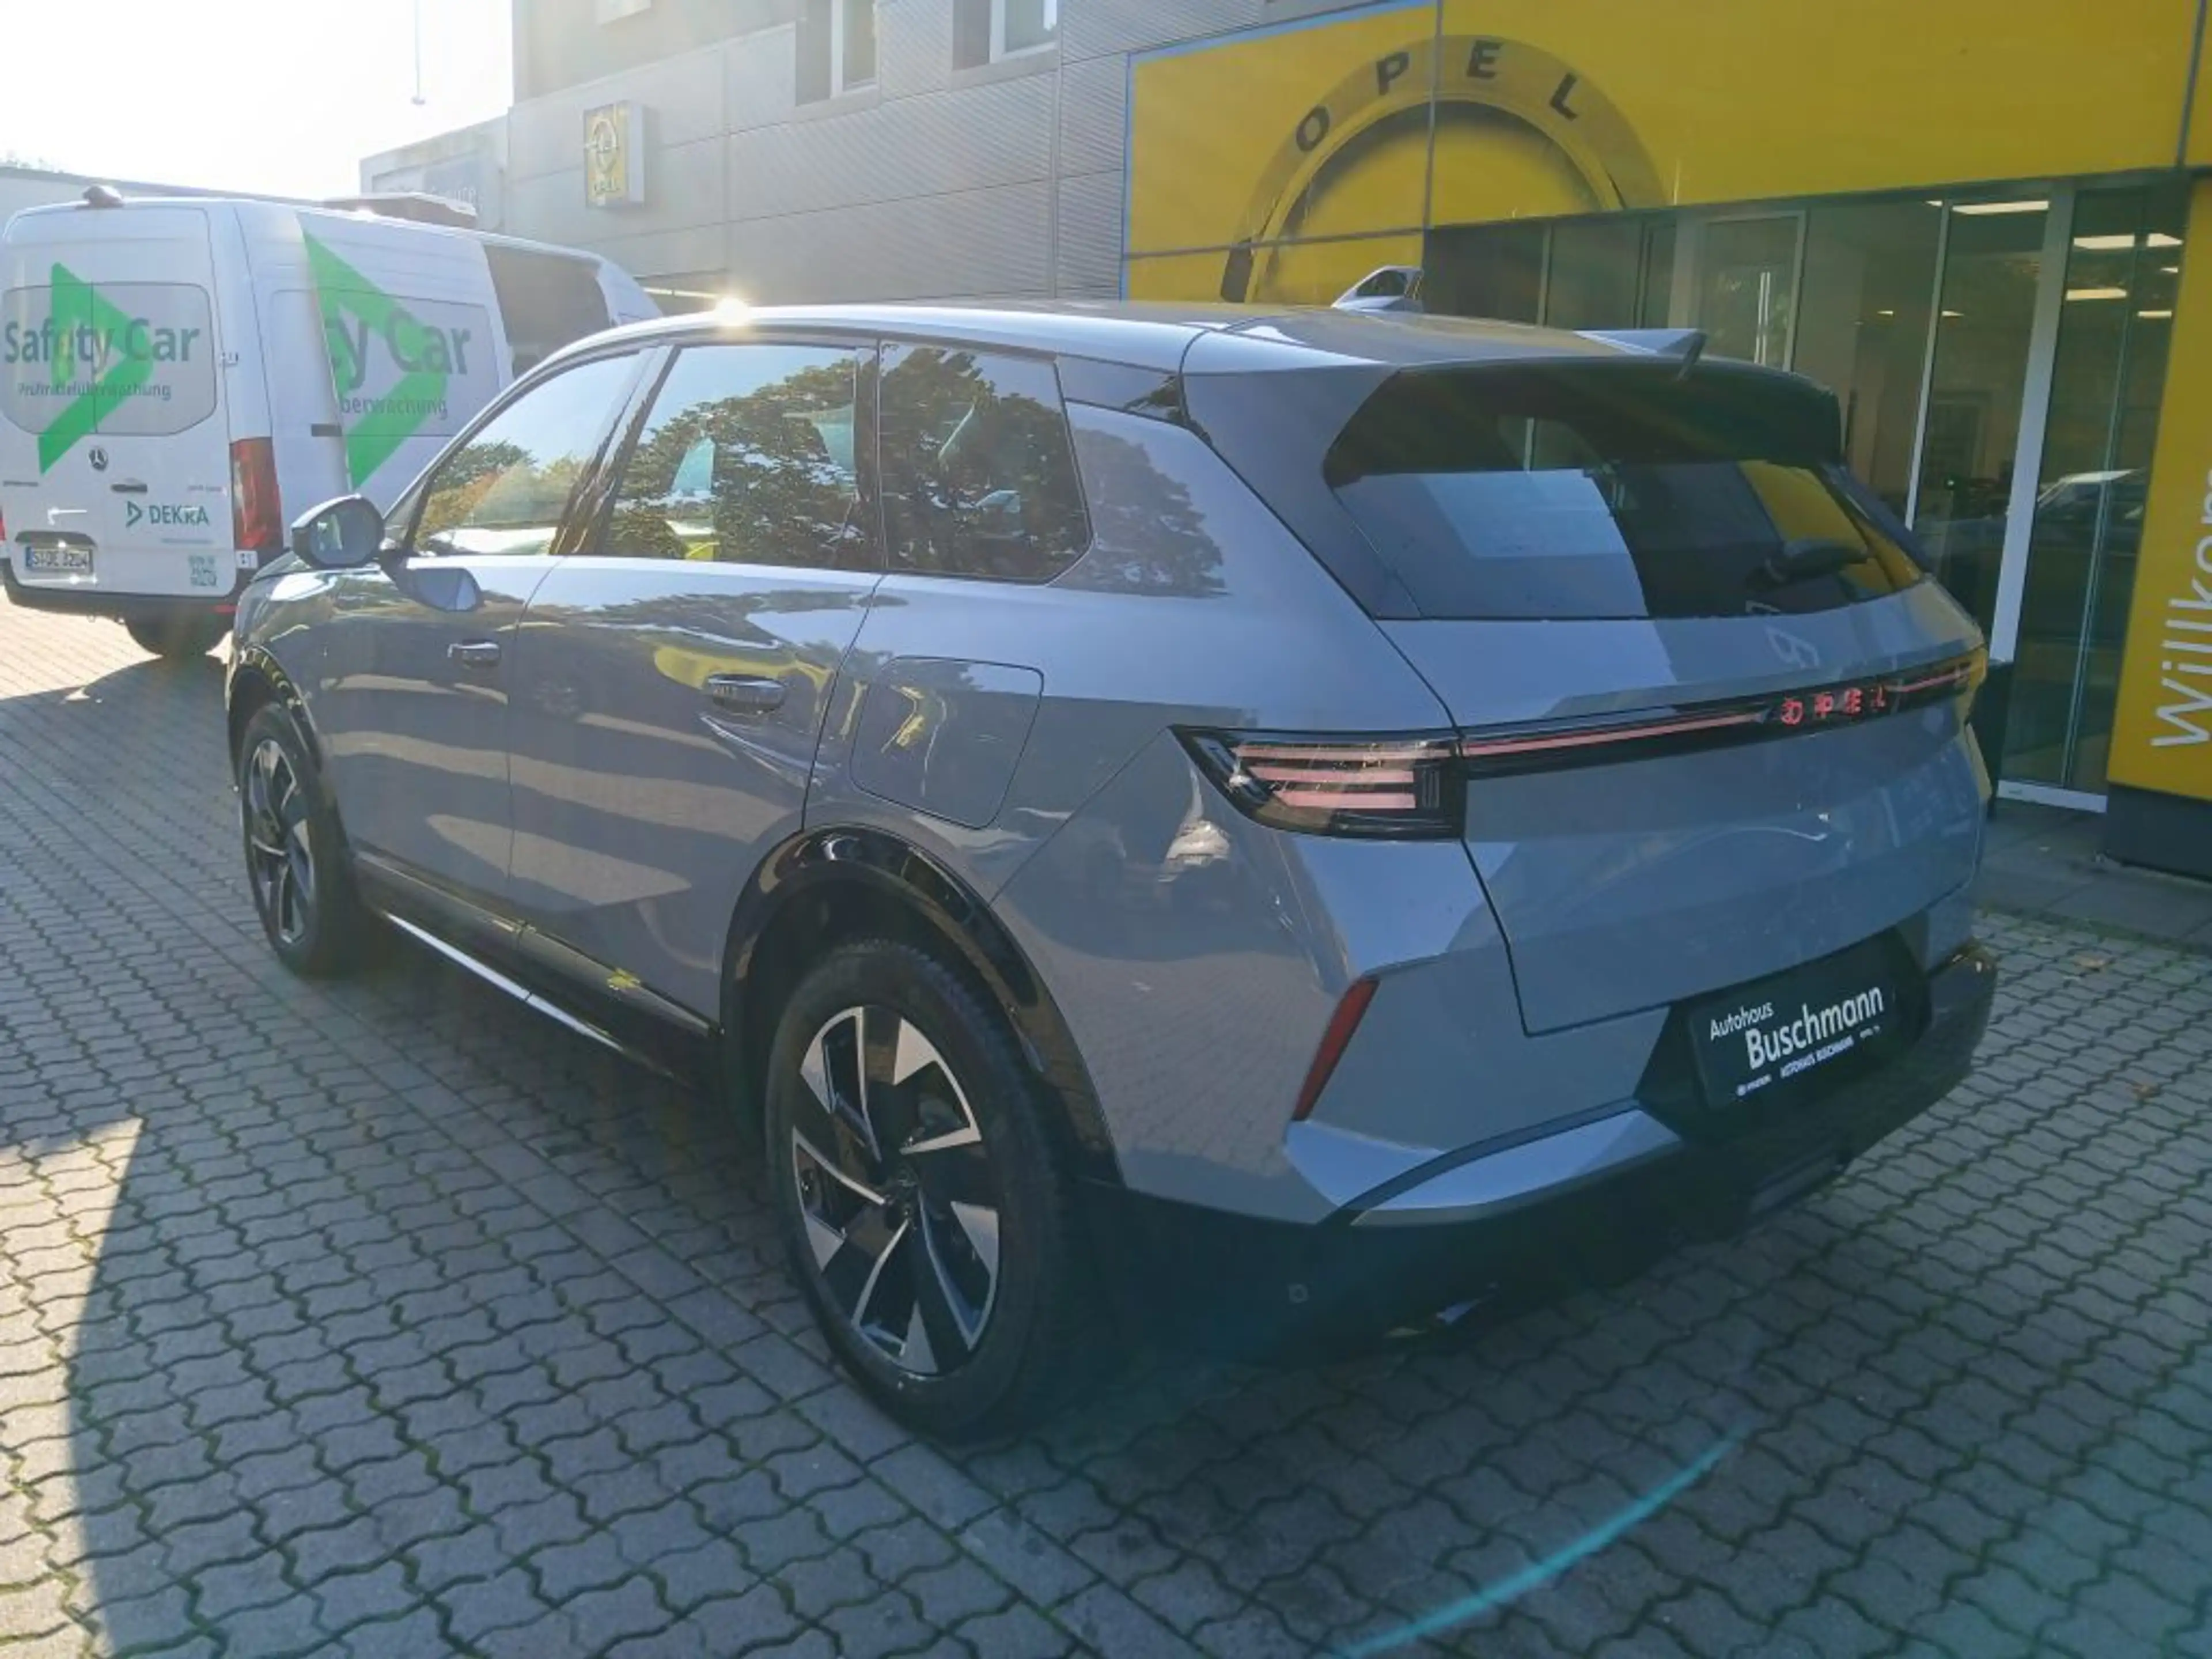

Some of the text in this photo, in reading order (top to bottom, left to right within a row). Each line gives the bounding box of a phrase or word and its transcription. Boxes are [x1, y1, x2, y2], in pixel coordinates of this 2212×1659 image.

[1296, 39, 1578, 152] OPEL
[125, 318, 200, 362] Car
[385, 308, 471, 375] Car
[2150, 469, 2212, 746] Willk
[1710, 1002, 1774, 1040] Autohaus
[1745, 987, 1884, 1070] Buschmann
